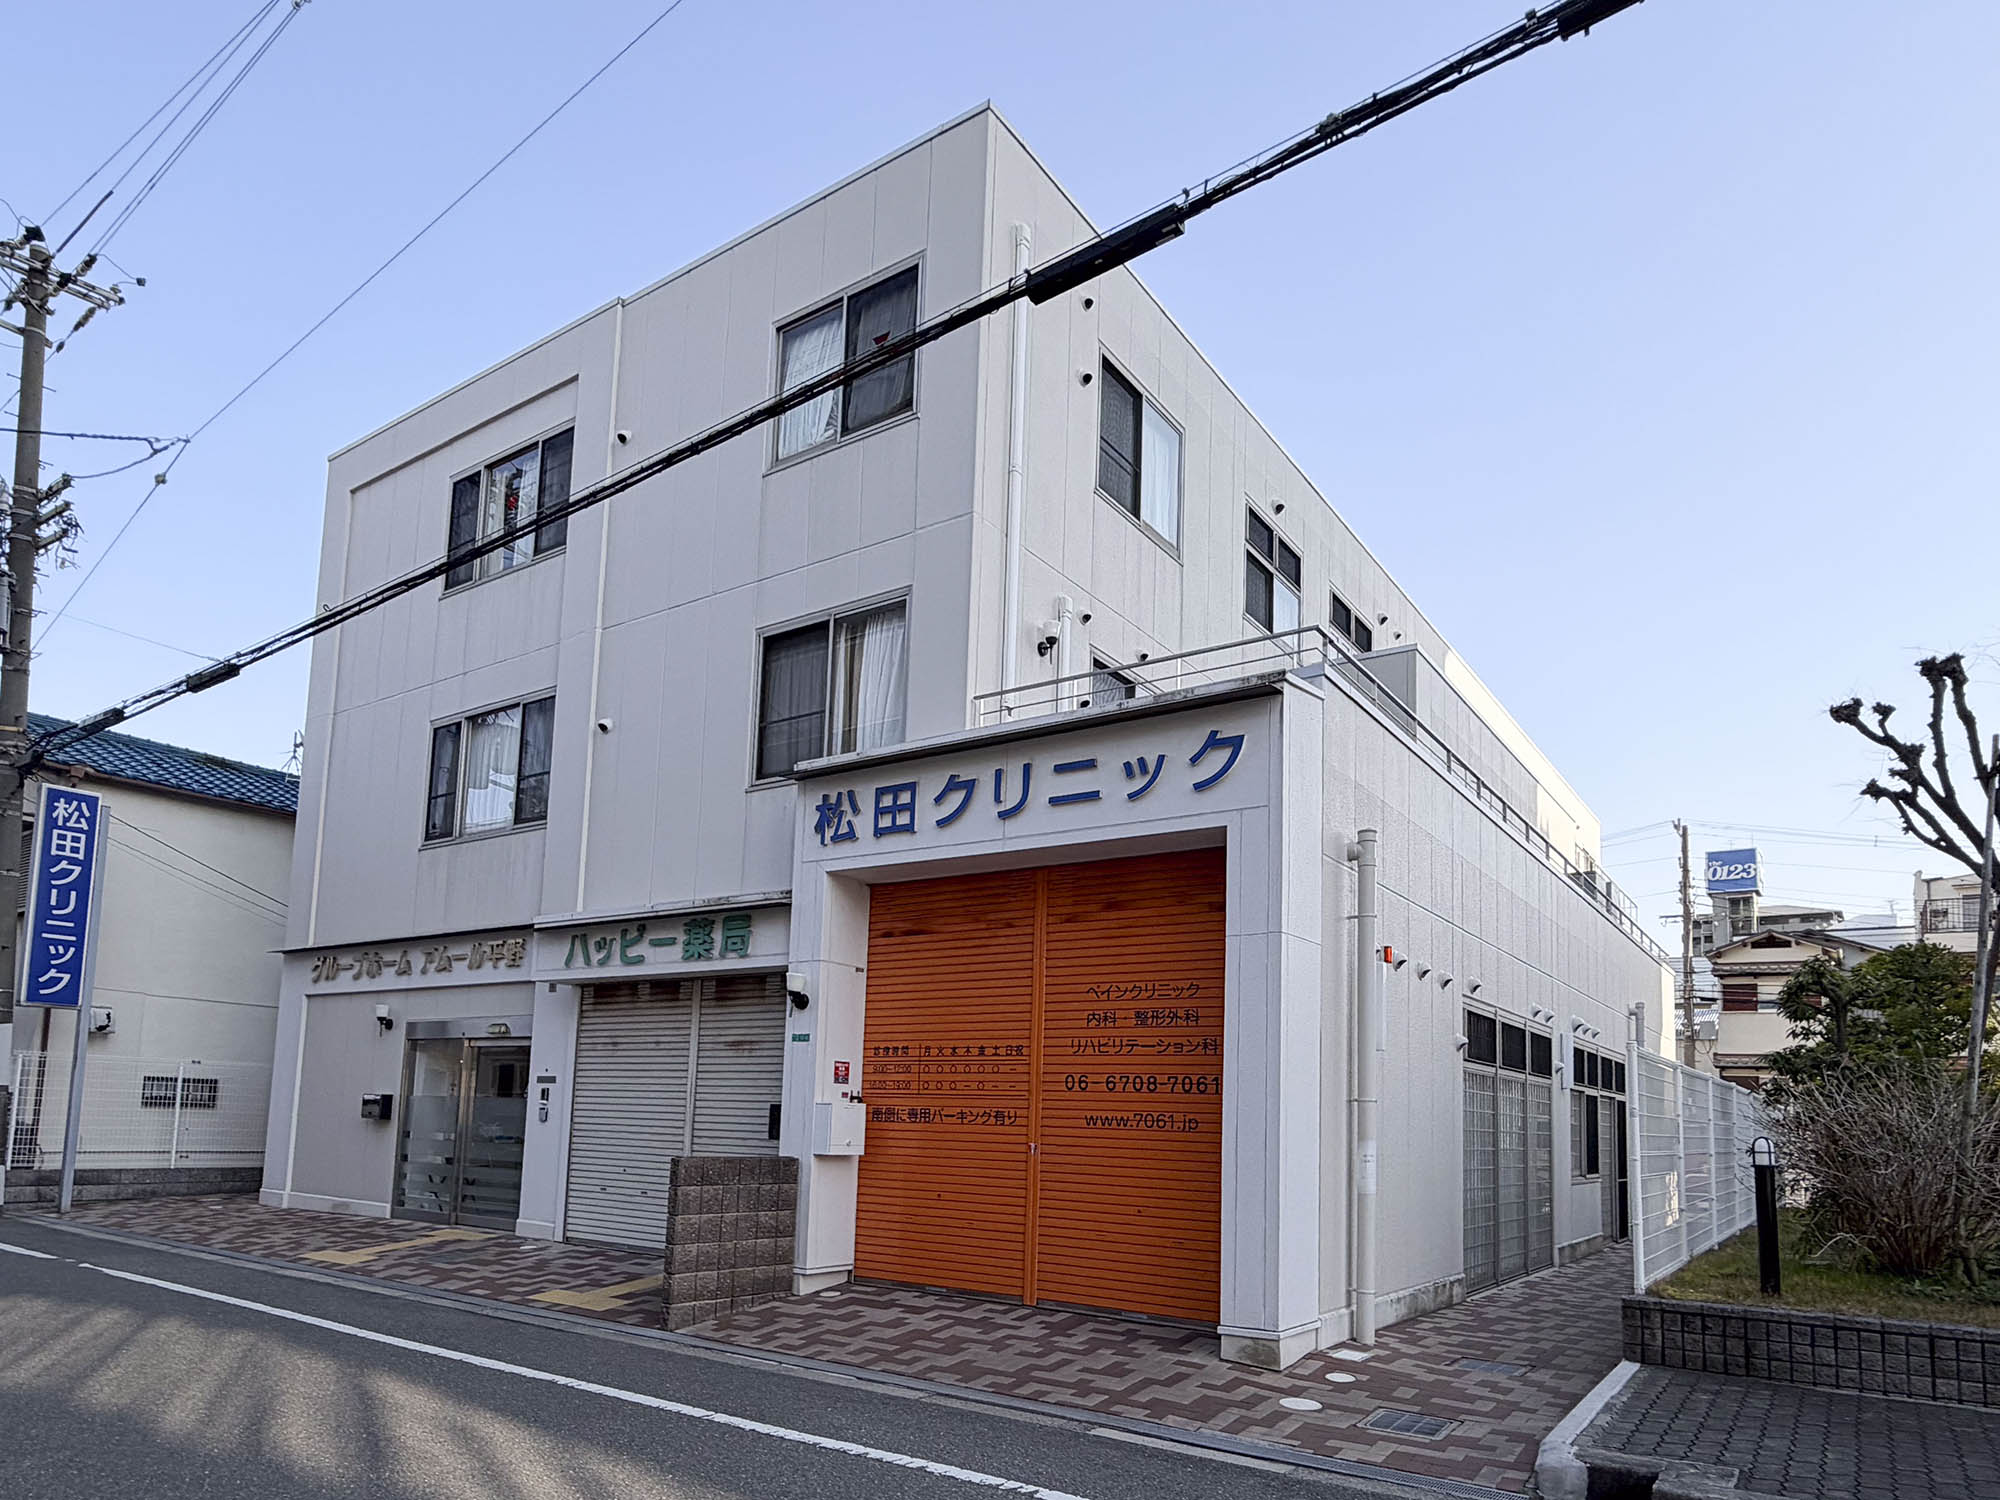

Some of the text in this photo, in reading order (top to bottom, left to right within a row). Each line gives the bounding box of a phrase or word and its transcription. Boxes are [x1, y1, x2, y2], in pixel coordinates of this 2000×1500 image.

[814, 730, 1246, 847] 松田クリニック
[1708, 863, 1756, 881] 0123
[38, 797, 91, 996] 松田クリニック
[564, 914, 752, 968] ハッピー薬局
[311, 937, 526, 984] グループホーム アムール平野
[1086, 982, 1200, 1001] ペインクリニック
[1071, 1037, 1219, 1056] リハビリテーション科
[1065, 1074, 1220, 1095] 06-6708-7061
[871, 1106, 1018, 1126] 南側に専用パーキング有り
[1084, 1113, 1199, 1132] www.7061.jp
